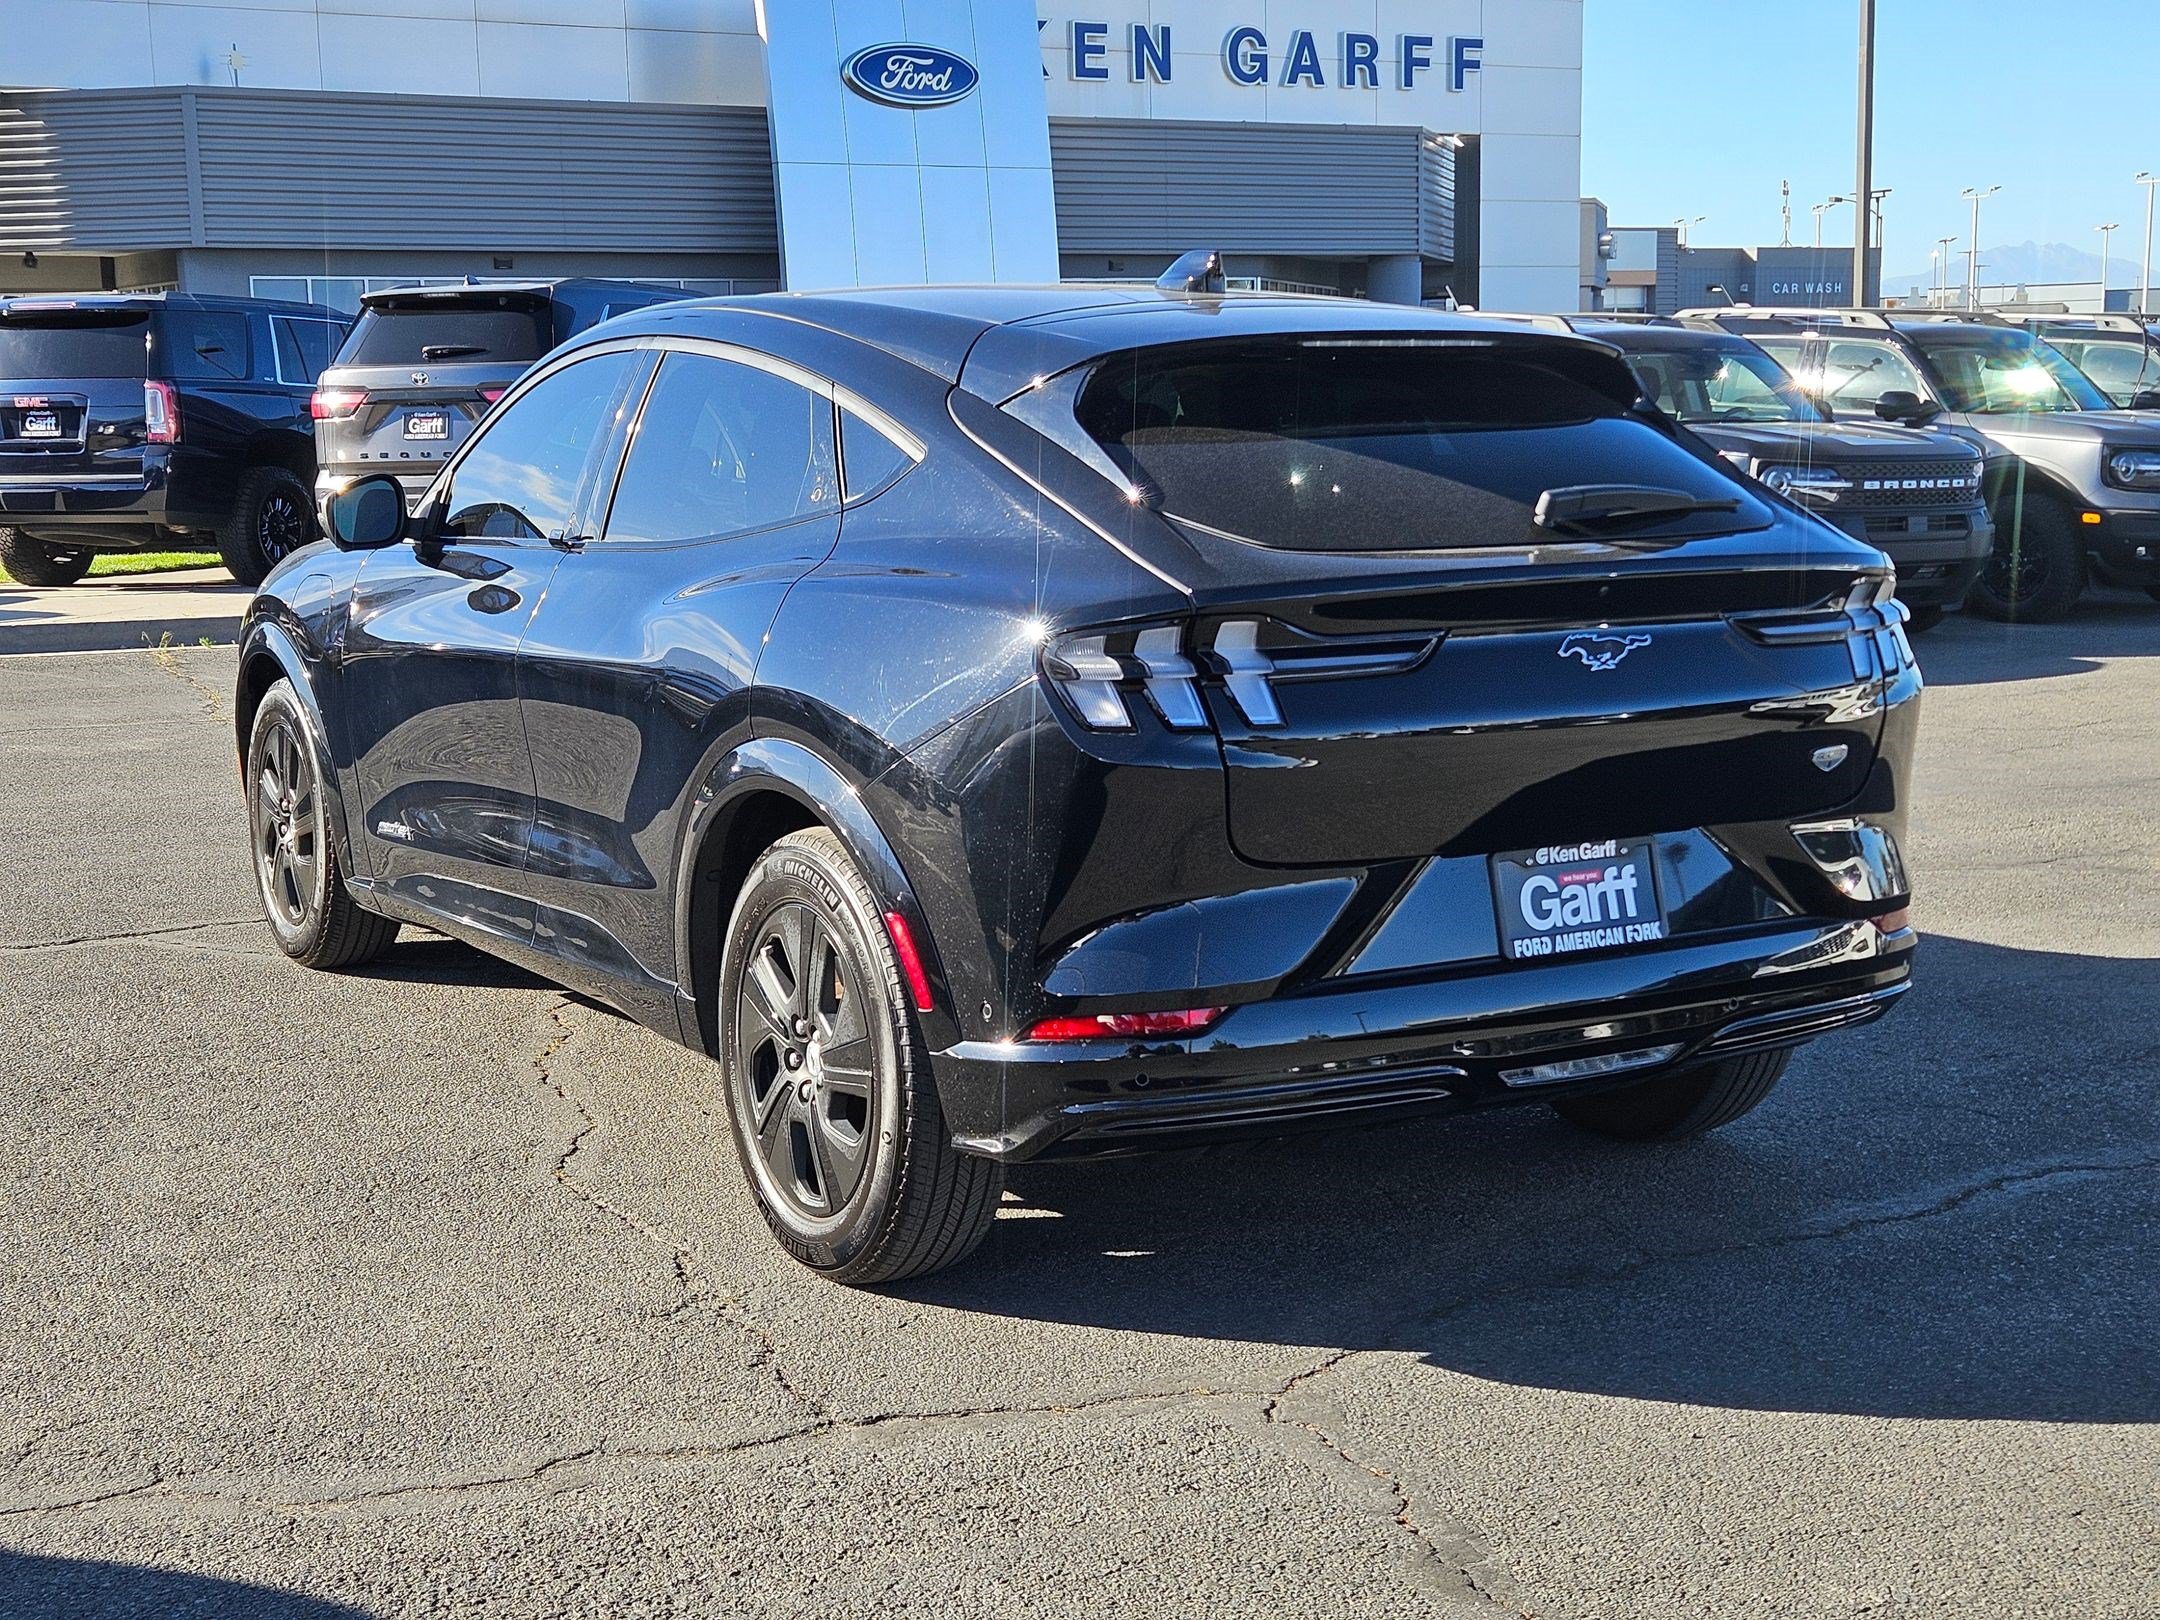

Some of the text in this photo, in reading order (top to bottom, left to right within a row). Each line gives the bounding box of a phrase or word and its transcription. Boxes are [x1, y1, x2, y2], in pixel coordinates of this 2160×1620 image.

[1223, 25, 1485, 92] GARFF
[880, 55, 952, 91] Ford
[1772, 282, 1842, 294] CAR WASH
[13, 396, 48, 408] GMC
[25, 416, 56, 431] Garff
[408, 417, 443, 434] Garff
[1863, 479, 1965, 490] BRONCO
[783, 860, 839, 908] MICHELIN
[1520, 864, 1638, 931] Garff
[1513, 921, 1662, 958] FORD AMERICAN FORK
